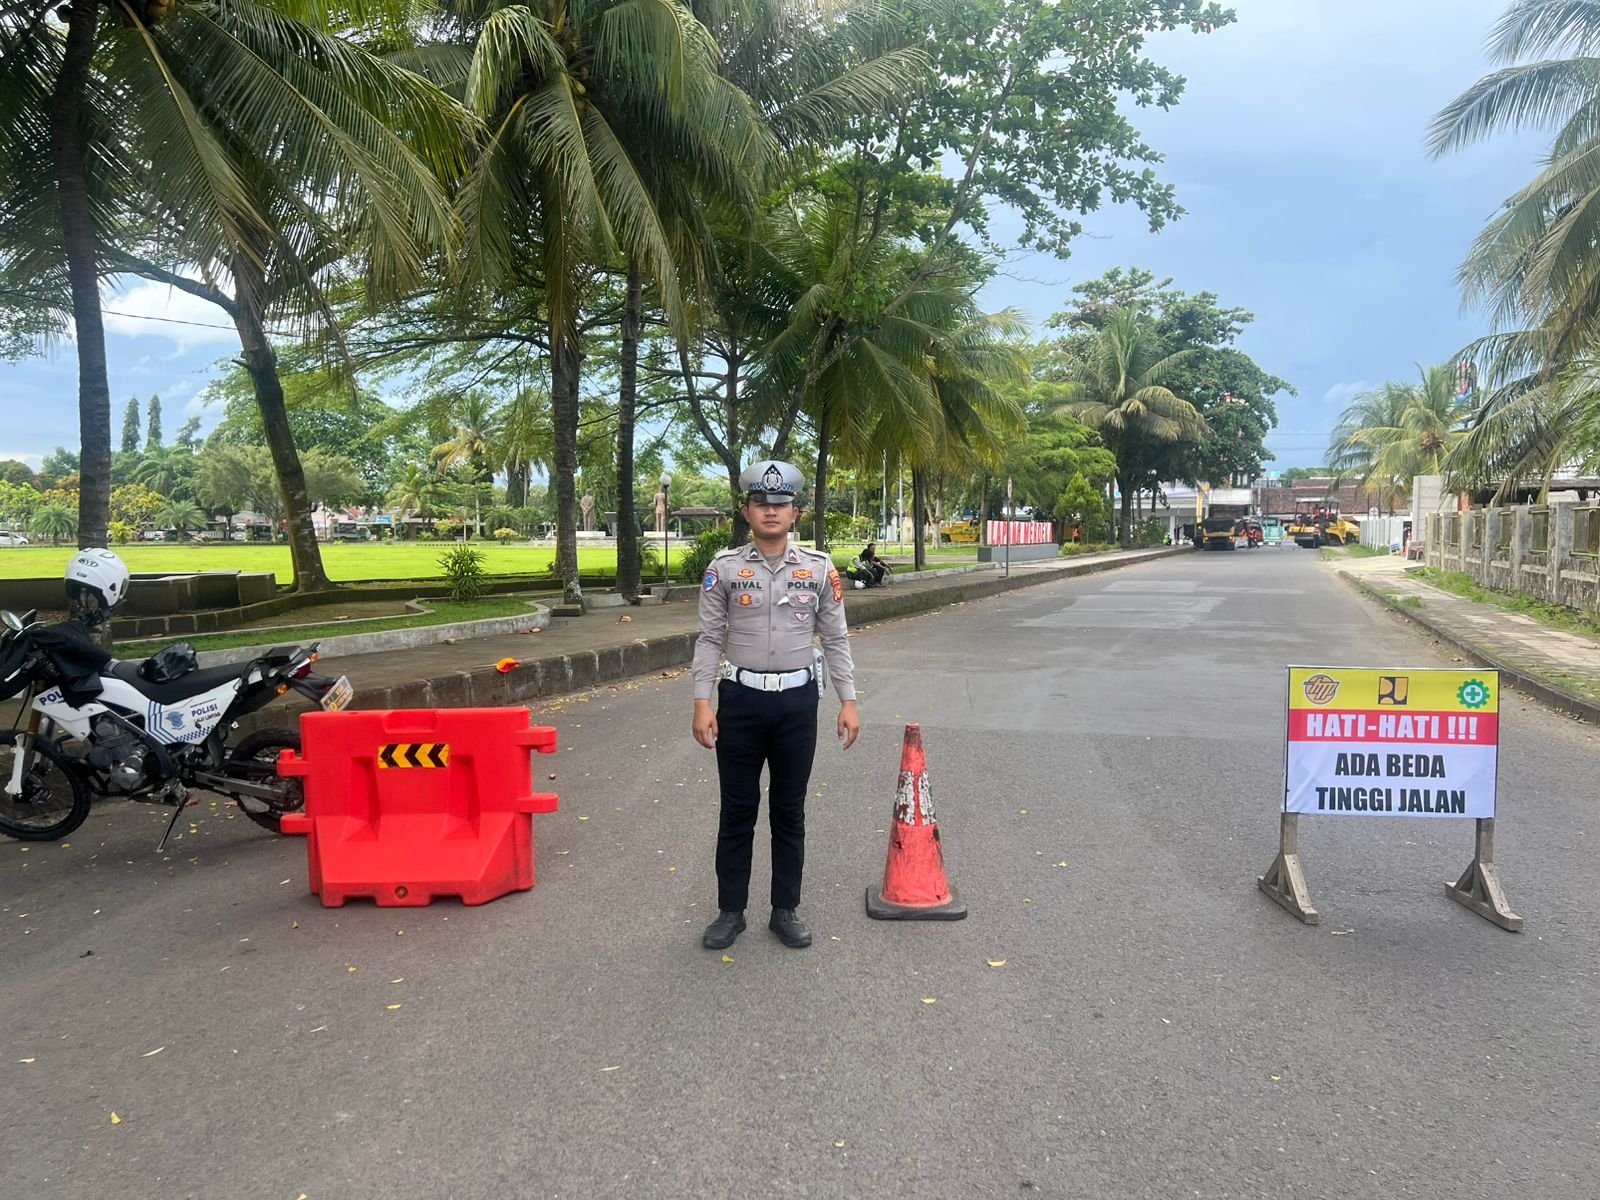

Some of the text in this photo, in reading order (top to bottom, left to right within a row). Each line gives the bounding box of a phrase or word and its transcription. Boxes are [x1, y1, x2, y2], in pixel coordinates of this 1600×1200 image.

[731, 581, 762, 589] RIVAL
[788, 581, 818, 590] POLRI
[191, 703, 218, 717] POLISI
[1306, 713, 1478, 740] HATI-HATI !!!
[1335, 752, 1446, 778] ADA BEDA
[1316, 787, 1466, 814] TINGGI JALAN
